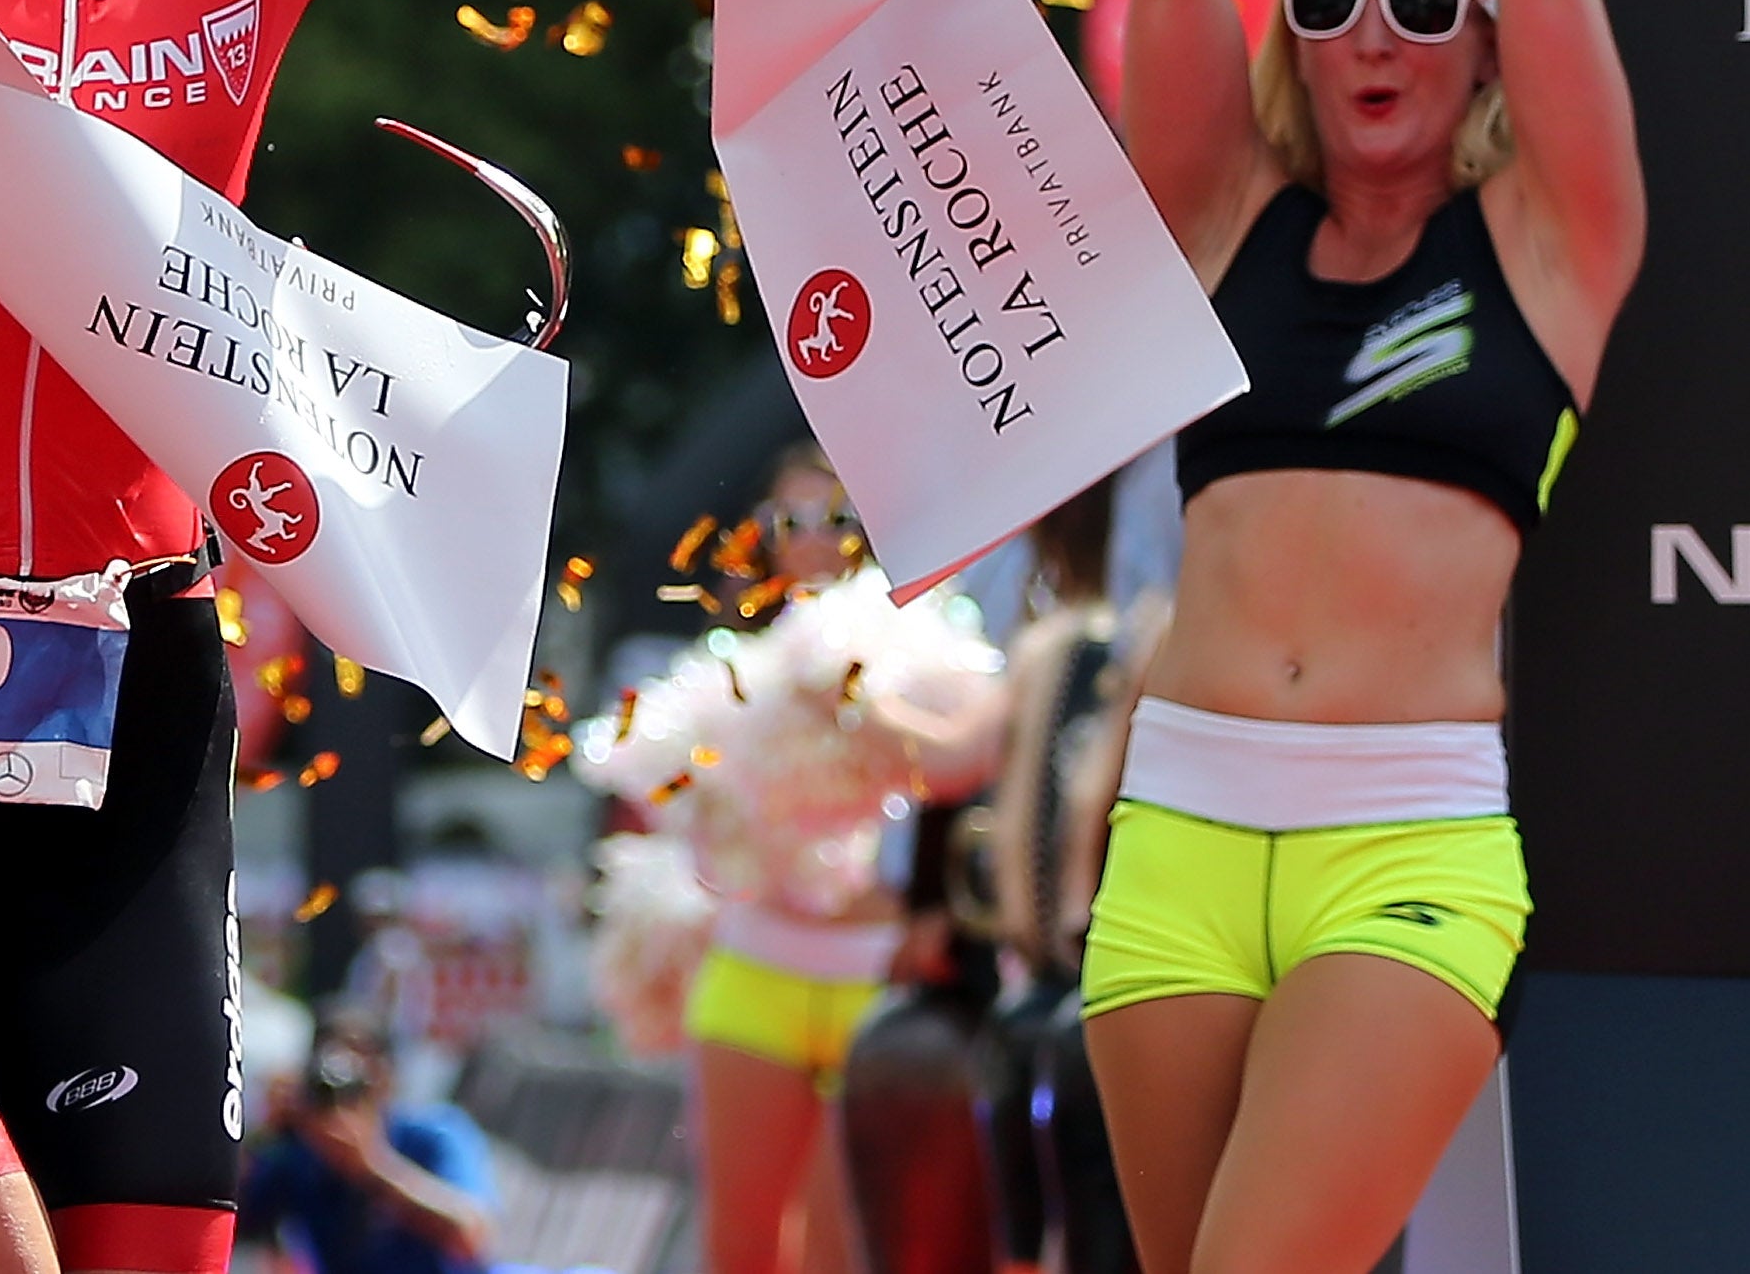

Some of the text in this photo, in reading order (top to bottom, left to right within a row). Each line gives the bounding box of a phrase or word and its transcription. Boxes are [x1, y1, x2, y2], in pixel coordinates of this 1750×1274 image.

[200, 200, 356, 312] PRIVATBANK
[824, 68, 1035, 437] NOTENSTEIN
[879, 64, 1067, 361] LA ROCHE
[977, 69, 1102, 267] PRIVATBANK
[86, 294, 426, 498] NOTENSTEIN
[158, 246, 398, 418] LA ROCHE
